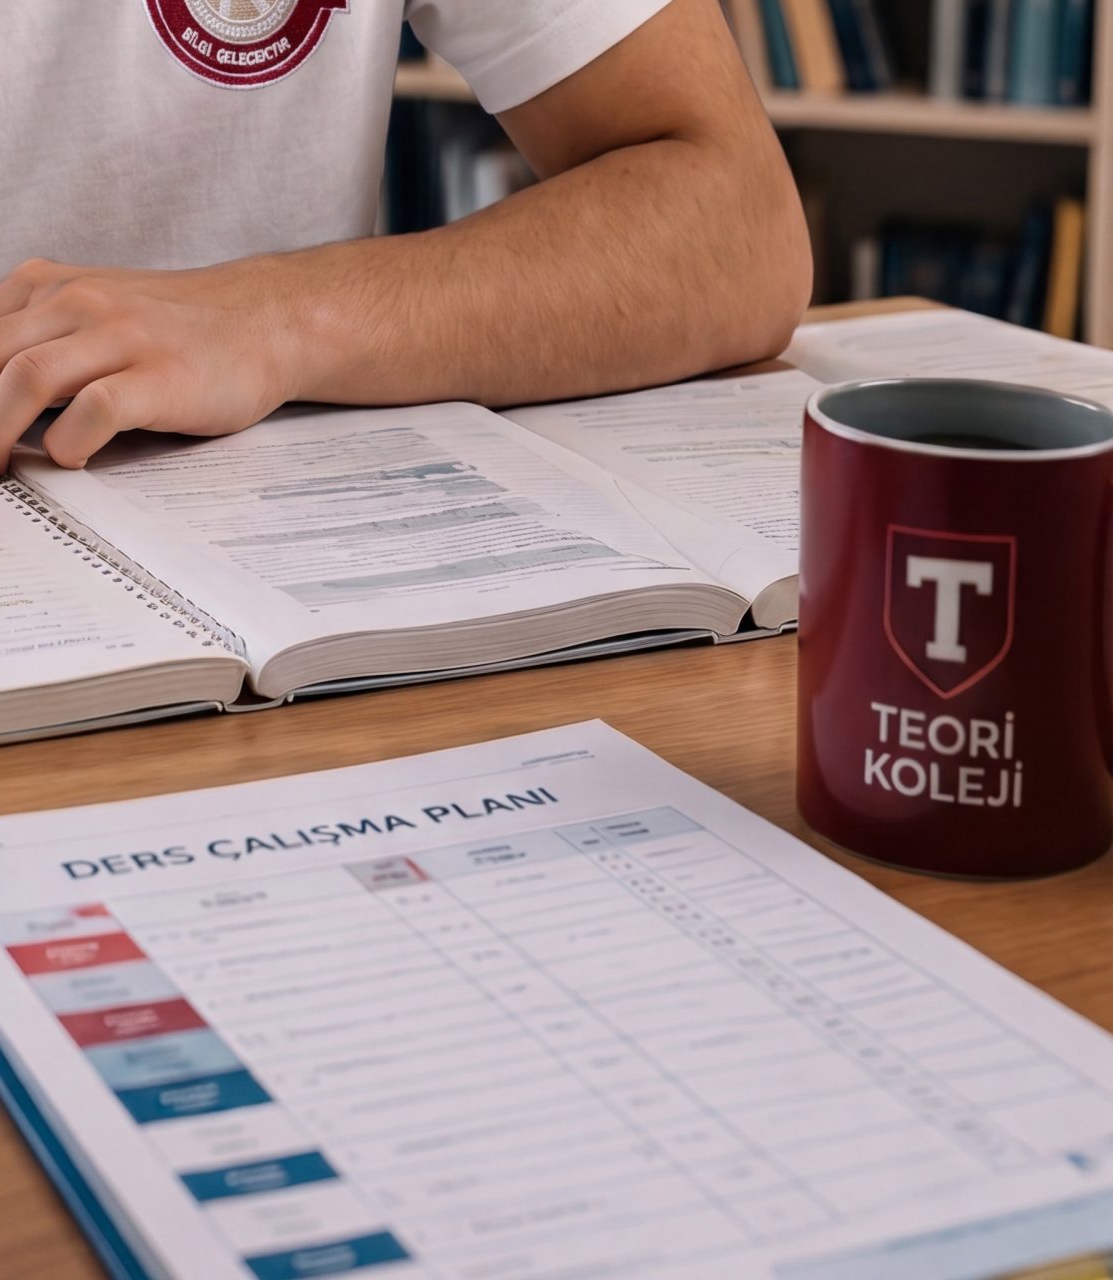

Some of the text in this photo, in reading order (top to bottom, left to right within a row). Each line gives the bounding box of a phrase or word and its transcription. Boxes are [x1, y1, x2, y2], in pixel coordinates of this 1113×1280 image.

[906, 555, 993, 663] T
[871, 701, 1015, 760] TEORİ
[863, 748, 1024, 808] KOLEJİ
[61, 786, 560, 880] DERS ÇALIŞMA PLANI
